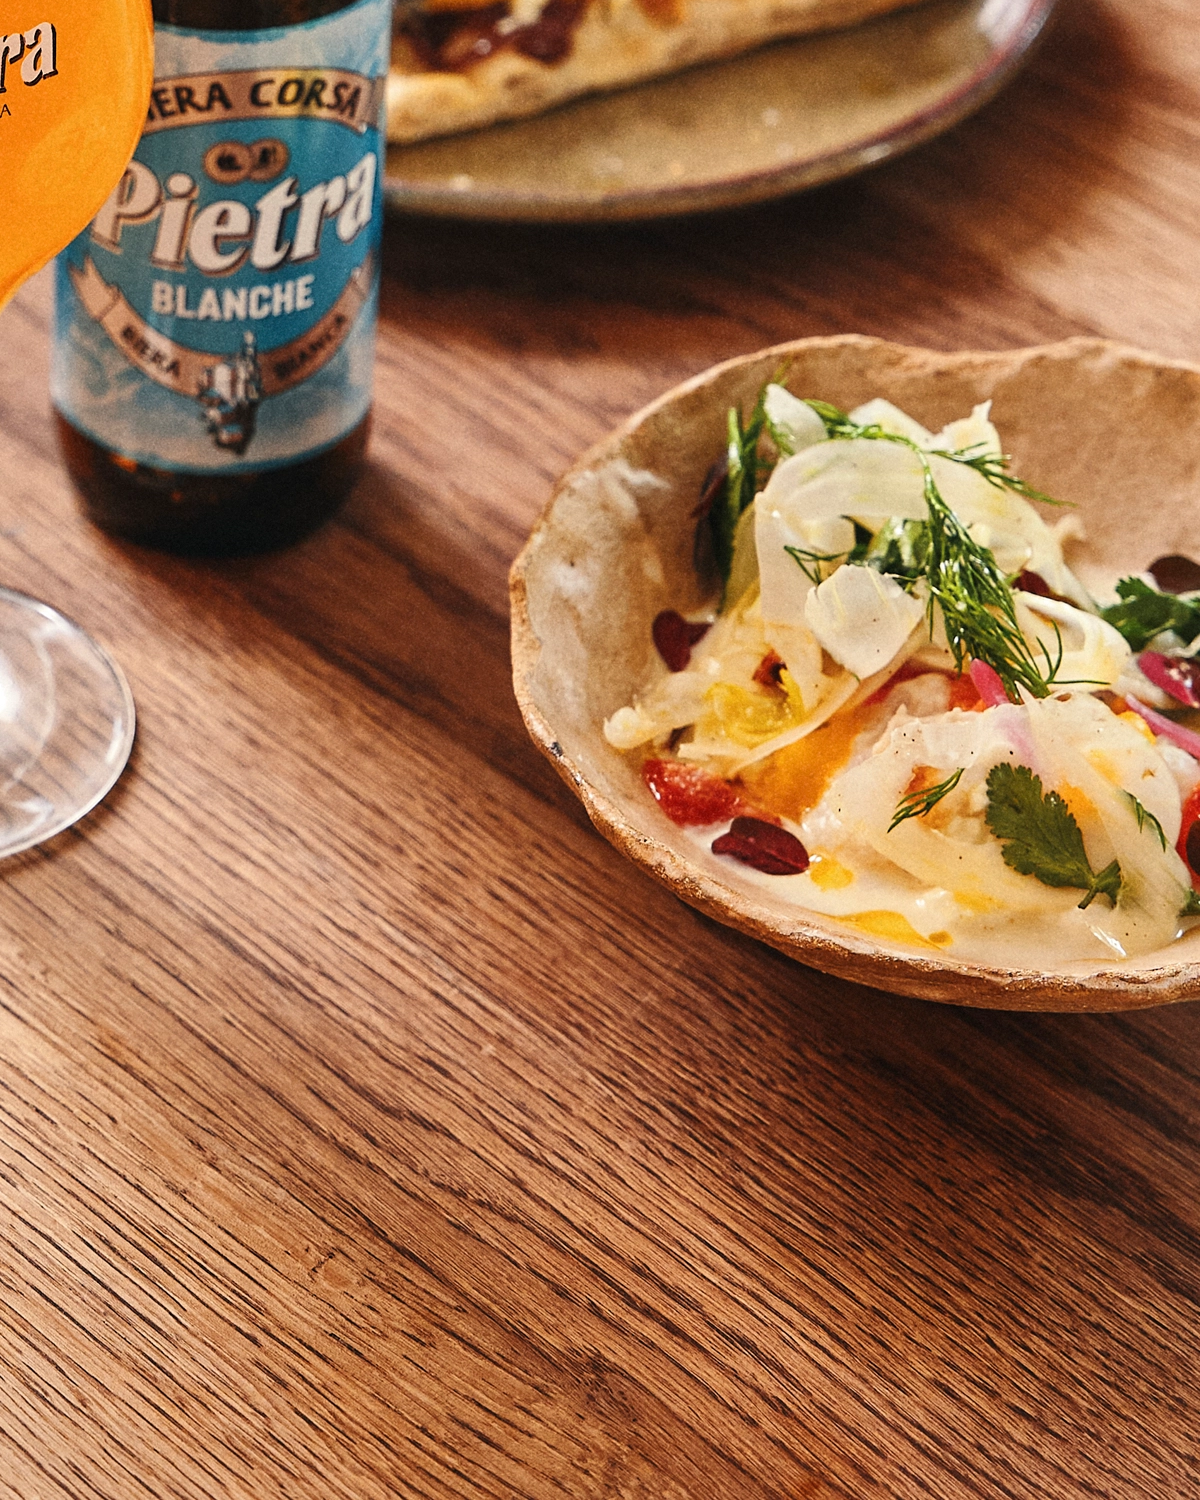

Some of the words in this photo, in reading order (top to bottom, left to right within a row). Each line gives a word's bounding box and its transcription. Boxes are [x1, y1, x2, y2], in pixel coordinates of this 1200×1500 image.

[147, 81, 233, 121] ERA
[250, 78, 362, 119] CORSA
[90, 152, 377, 278] Pietra
[151, 274, 316, 322] BLANCHE
